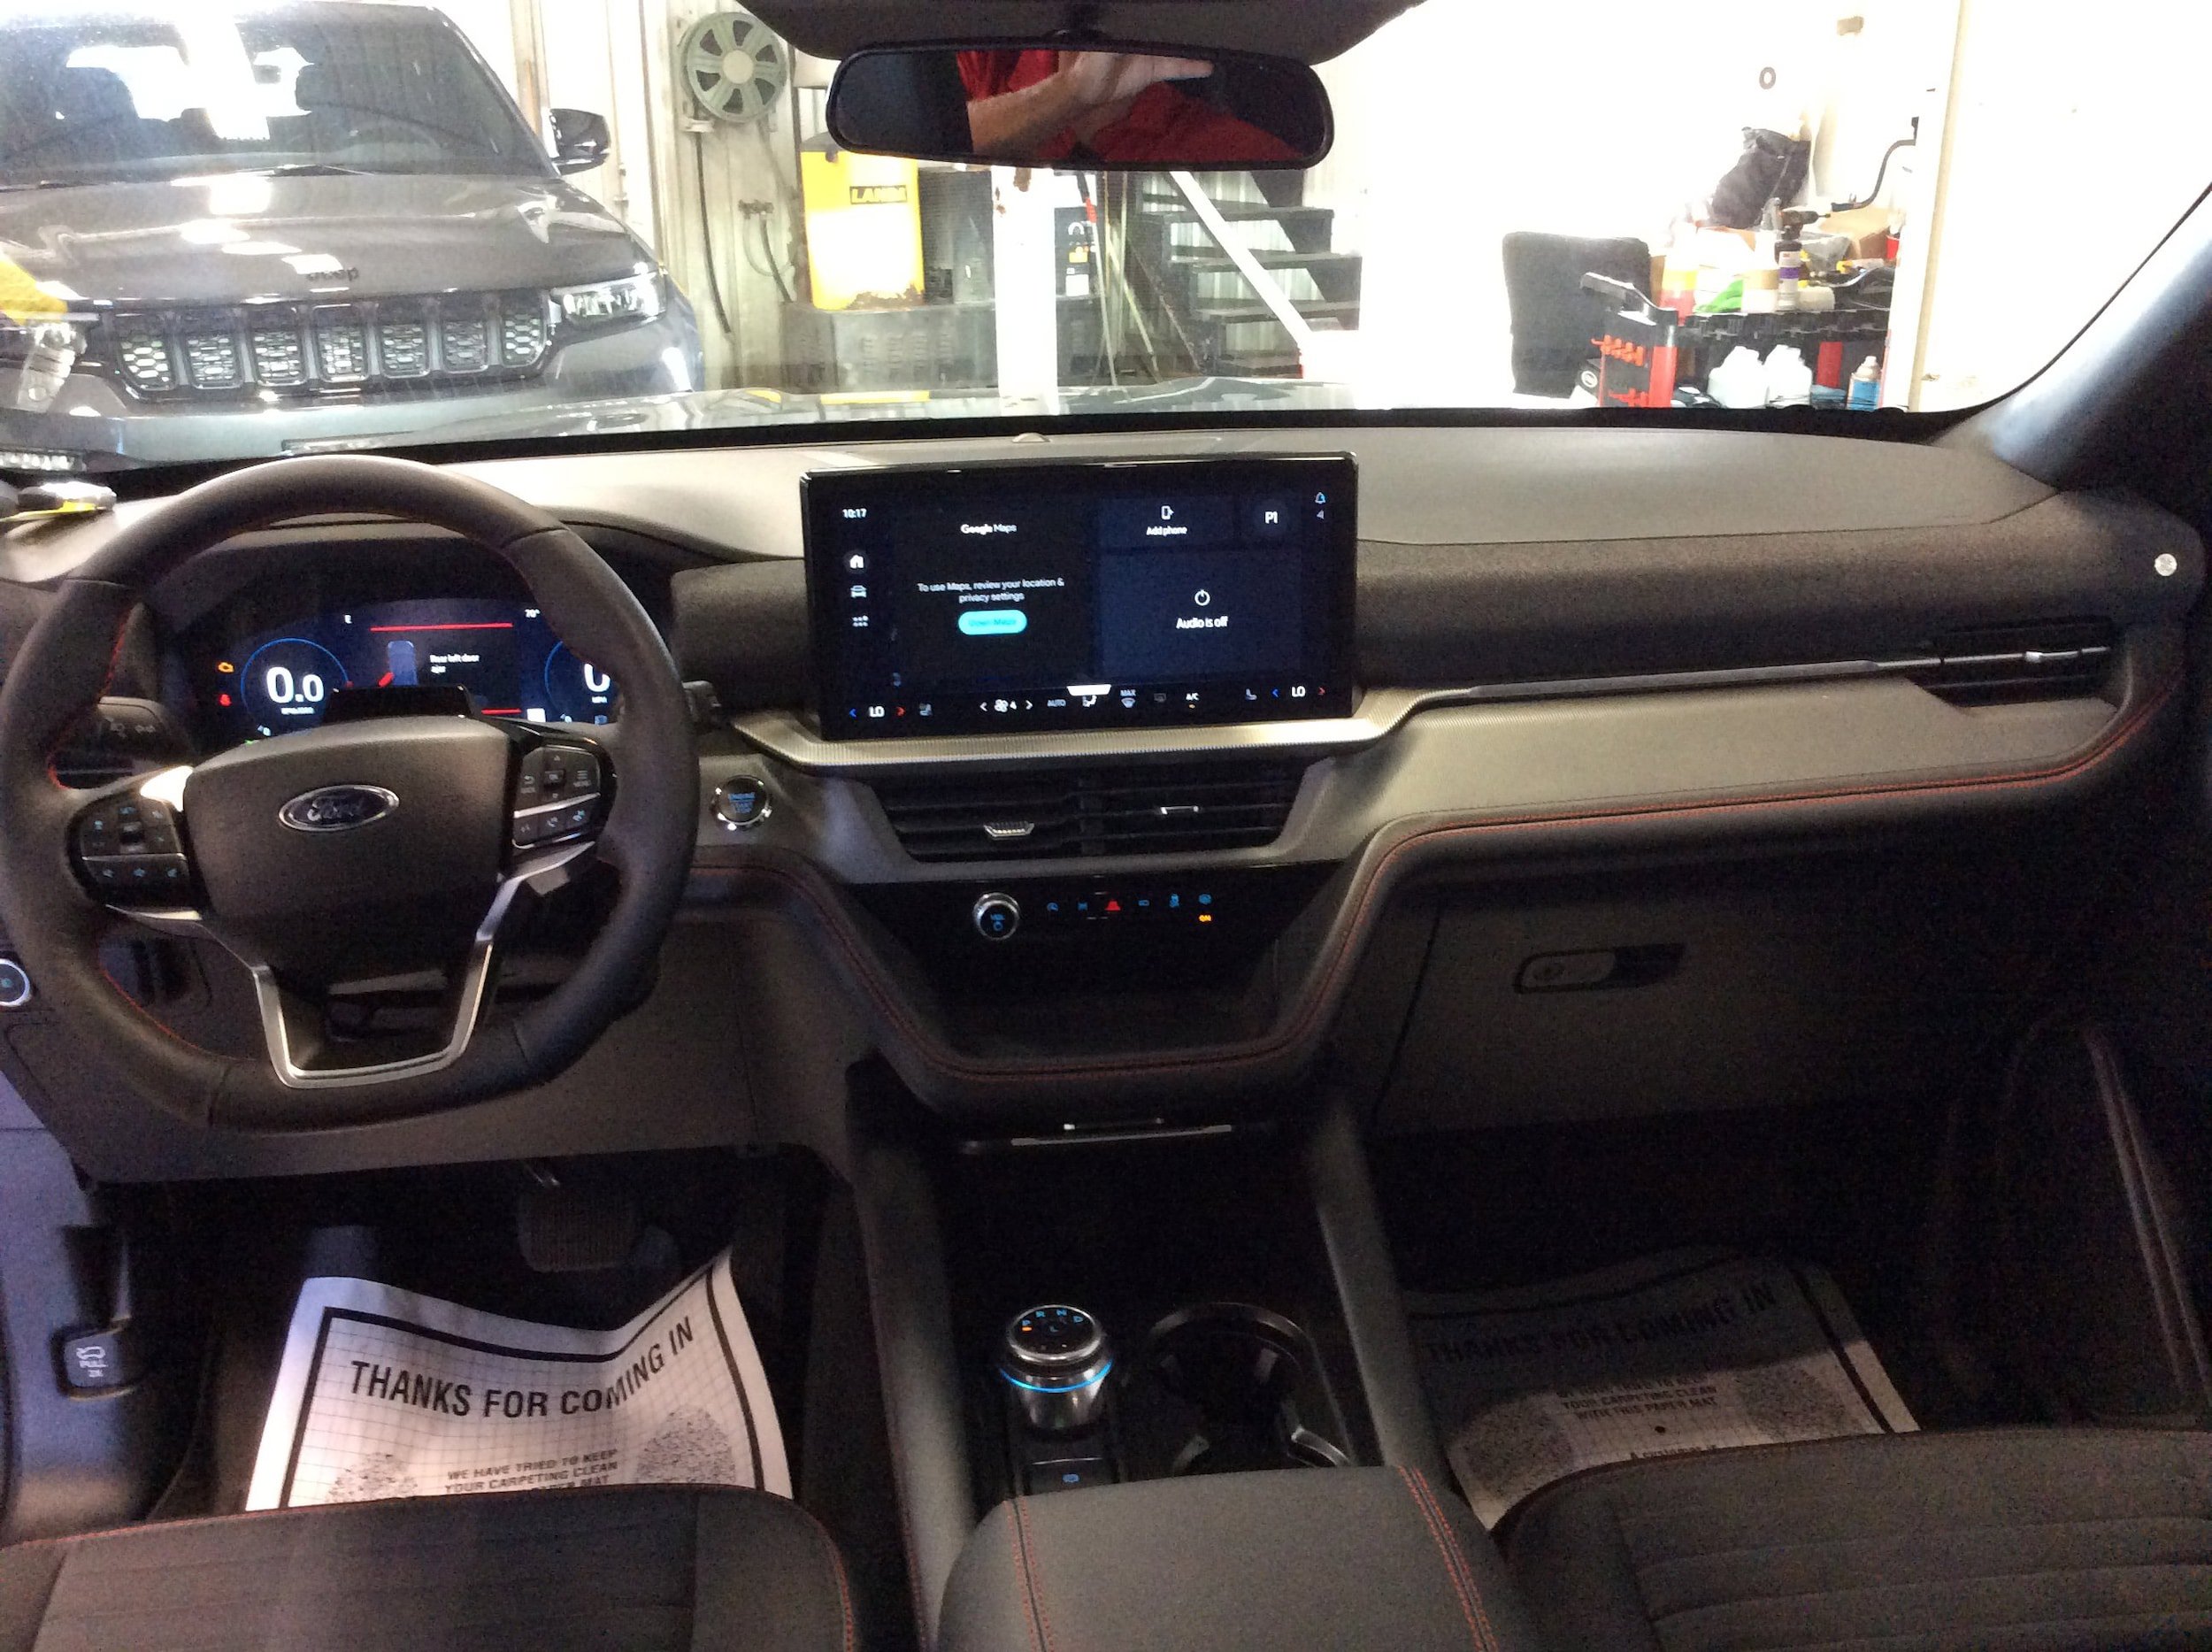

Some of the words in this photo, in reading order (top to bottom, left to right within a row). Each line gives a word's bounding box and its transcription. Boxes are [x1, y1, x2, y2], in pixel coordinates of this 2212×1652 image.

[842, 509, 867, 519] 10:17
[961, 524, 993, 534] Google
[994, 524, 1017, 534] Maps
[1146, 526, 1163, 535] Add
[1163, 526, 1187, 537] phone
[917, 583, 929, 592] To
[973, 580, 1001, 590] review
[1001, 580, 1021, 590] your
[1022, 579, 1056, 588] location
[958, 593, 990, 603] privacy
[991, 592, 1025, 602] settings
[1176, 618, 1204, 629] Audio
[1205, 618, 1213, 628] is
[1214, 615, 1228, 627] off
[266, 666, 325, 703] 0.0
[1291, 685, 1306, 697] LO
[1742, 1280, 1778, 1314] IN
[1073, 1315, 1084, 1324] D
[350, 1360, 472, 1417] THANKS
[484, 1388, 549, 1418] FOR
[561, 1343, 664, 1415] COMING
[669, 1316, 693, 1356] IN
[473, 1464, 510, 1478] HAVE
[516, 1459, 557, 1472] TRIED
[562, 1456, 580, 1465] TO
[583, 1448, 618, 1461] KEEP
[444, 1481, 485, 1494] YOUR
[488, 1471, 570, 1489] CARPETING
[573, 1461, 619, 1478] CLEAN
